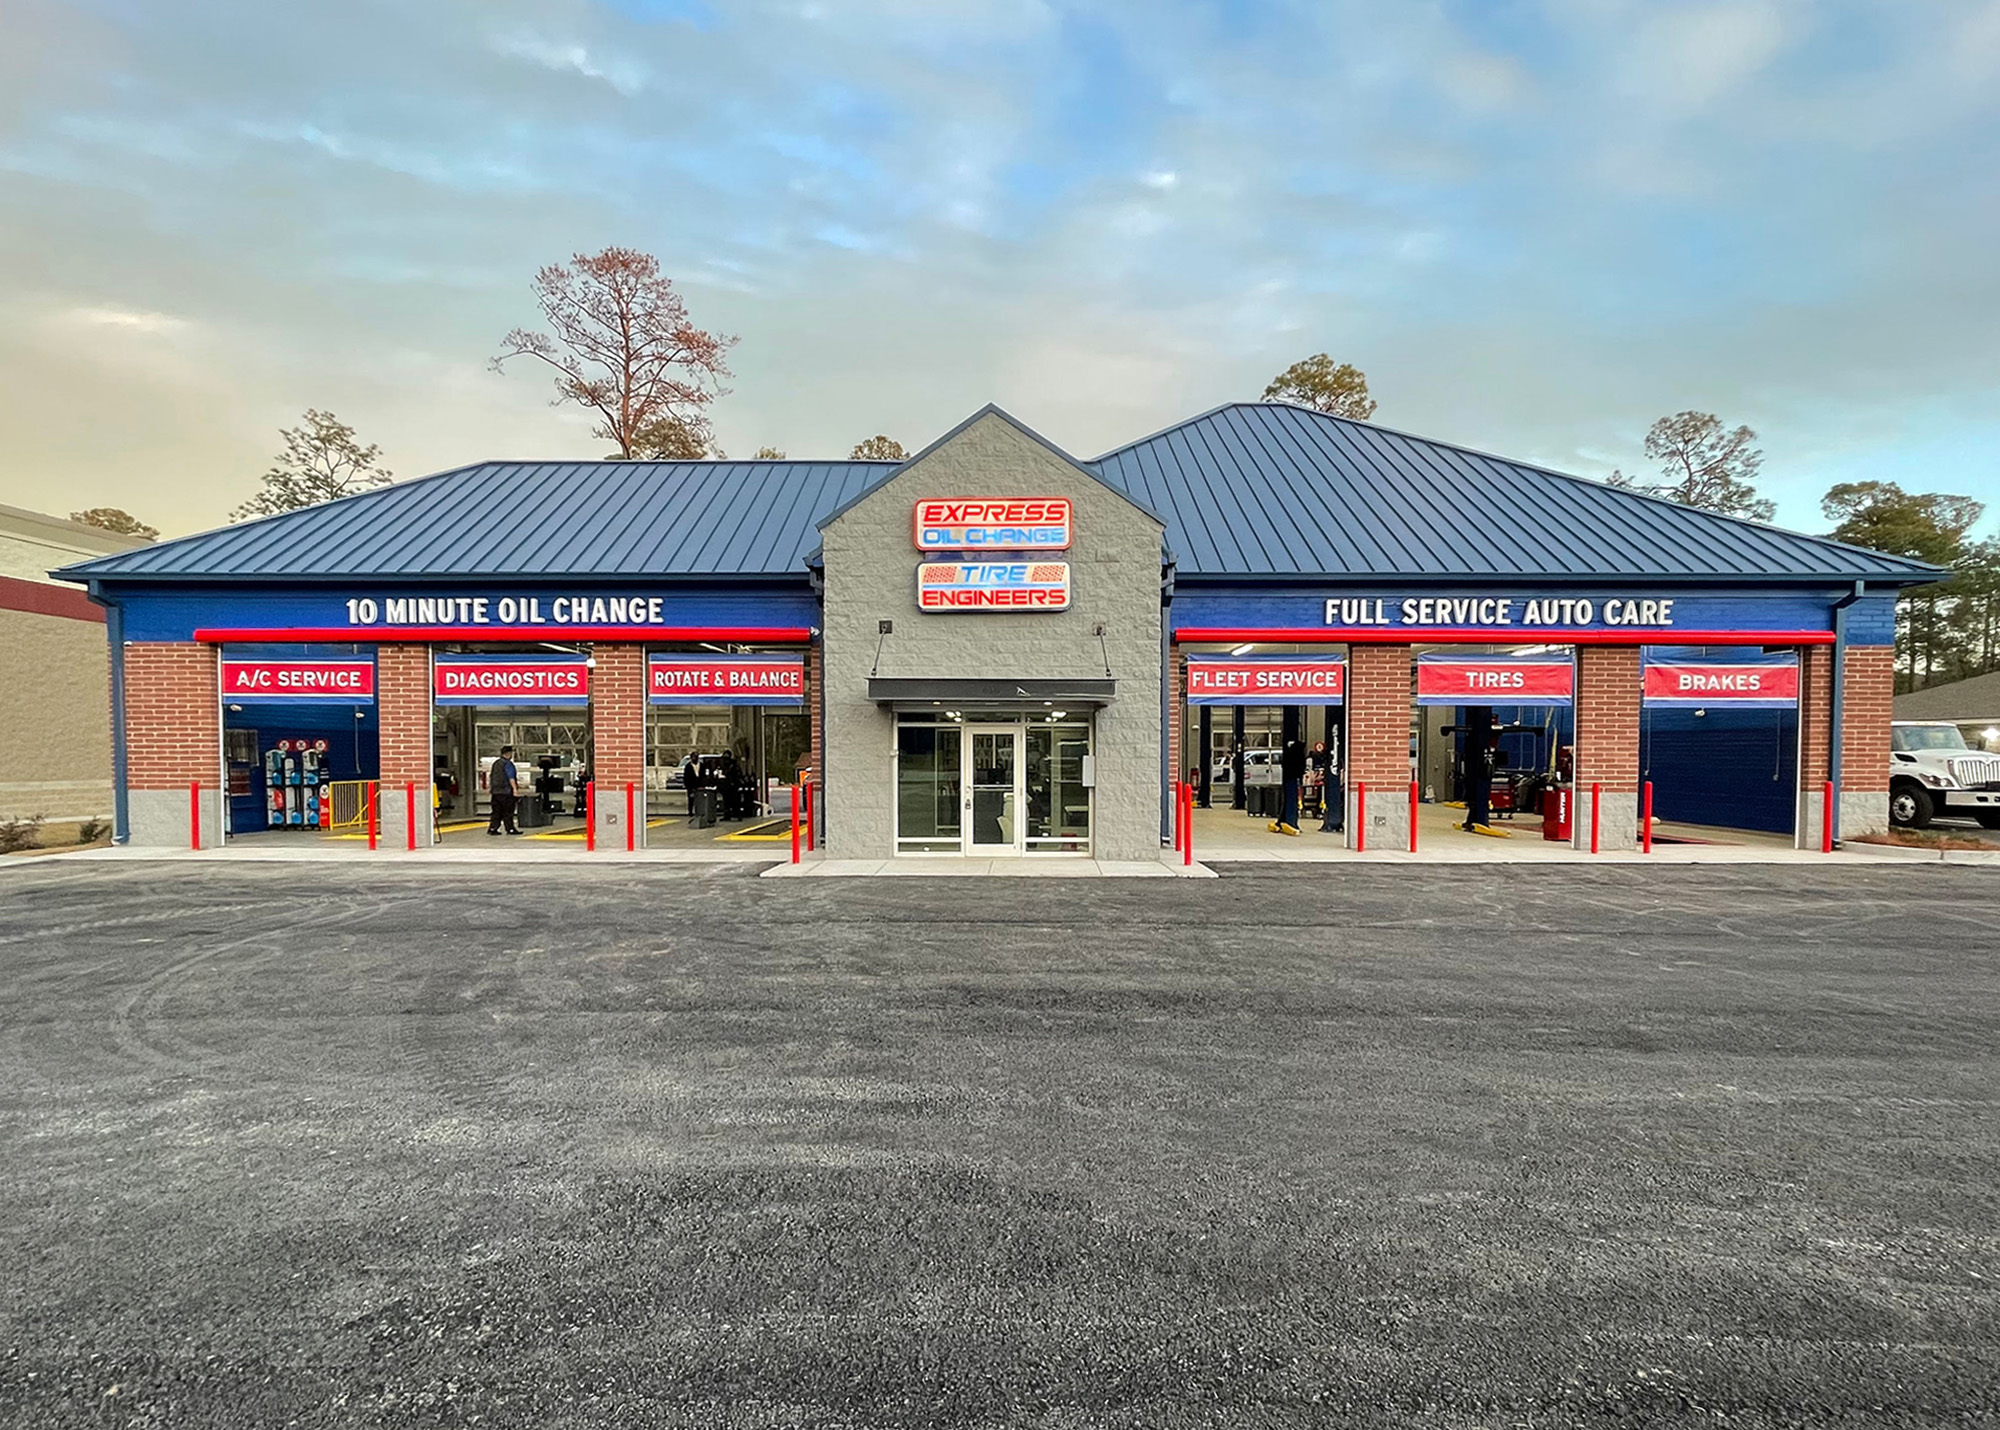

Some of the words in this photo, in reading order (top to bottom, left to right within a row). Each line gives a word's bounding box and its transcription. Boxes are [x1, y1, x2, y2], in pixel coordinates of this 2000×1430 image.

[923, 504, 1066, 521] EXPRESS
[923, 529, 960, 544] OIL
[966, 528, 1065, 543] CHANGE
[961, 566, 1027, 581] TIRE
[922, 590, 1066, 605] ENGINEERS
[346, 599, 378, 624] 10
[386, 599, 489, 624] MINUTE
[498, 598, 545, 623] OIL
[552, 598, 664, 623] CHANGE
[1325, 599, 1389, 625] FULL
[1402, 599, 1512, 625] SERVICE
[1523, 599, 1593, 625] AUTO
[1603, 599, 1673, 625] CARE
[236, 669, 272, 688] A/C
[277, 670, 361, 687] SERVICE
[445, 671, 579, 689] DIAGNOSTICS
[654, 670, 709, 688] ROTATE
[714, 672, 725, 687] &
[729, 671, 799, 688] BALANCE
[1192, 672, 1251, 689] FLEET
[1256, 671, 1337, 688] SERVICE
[1466, 672, 1524, 689] TIRES
[1679, 673, 1760, 691] BRAKES
